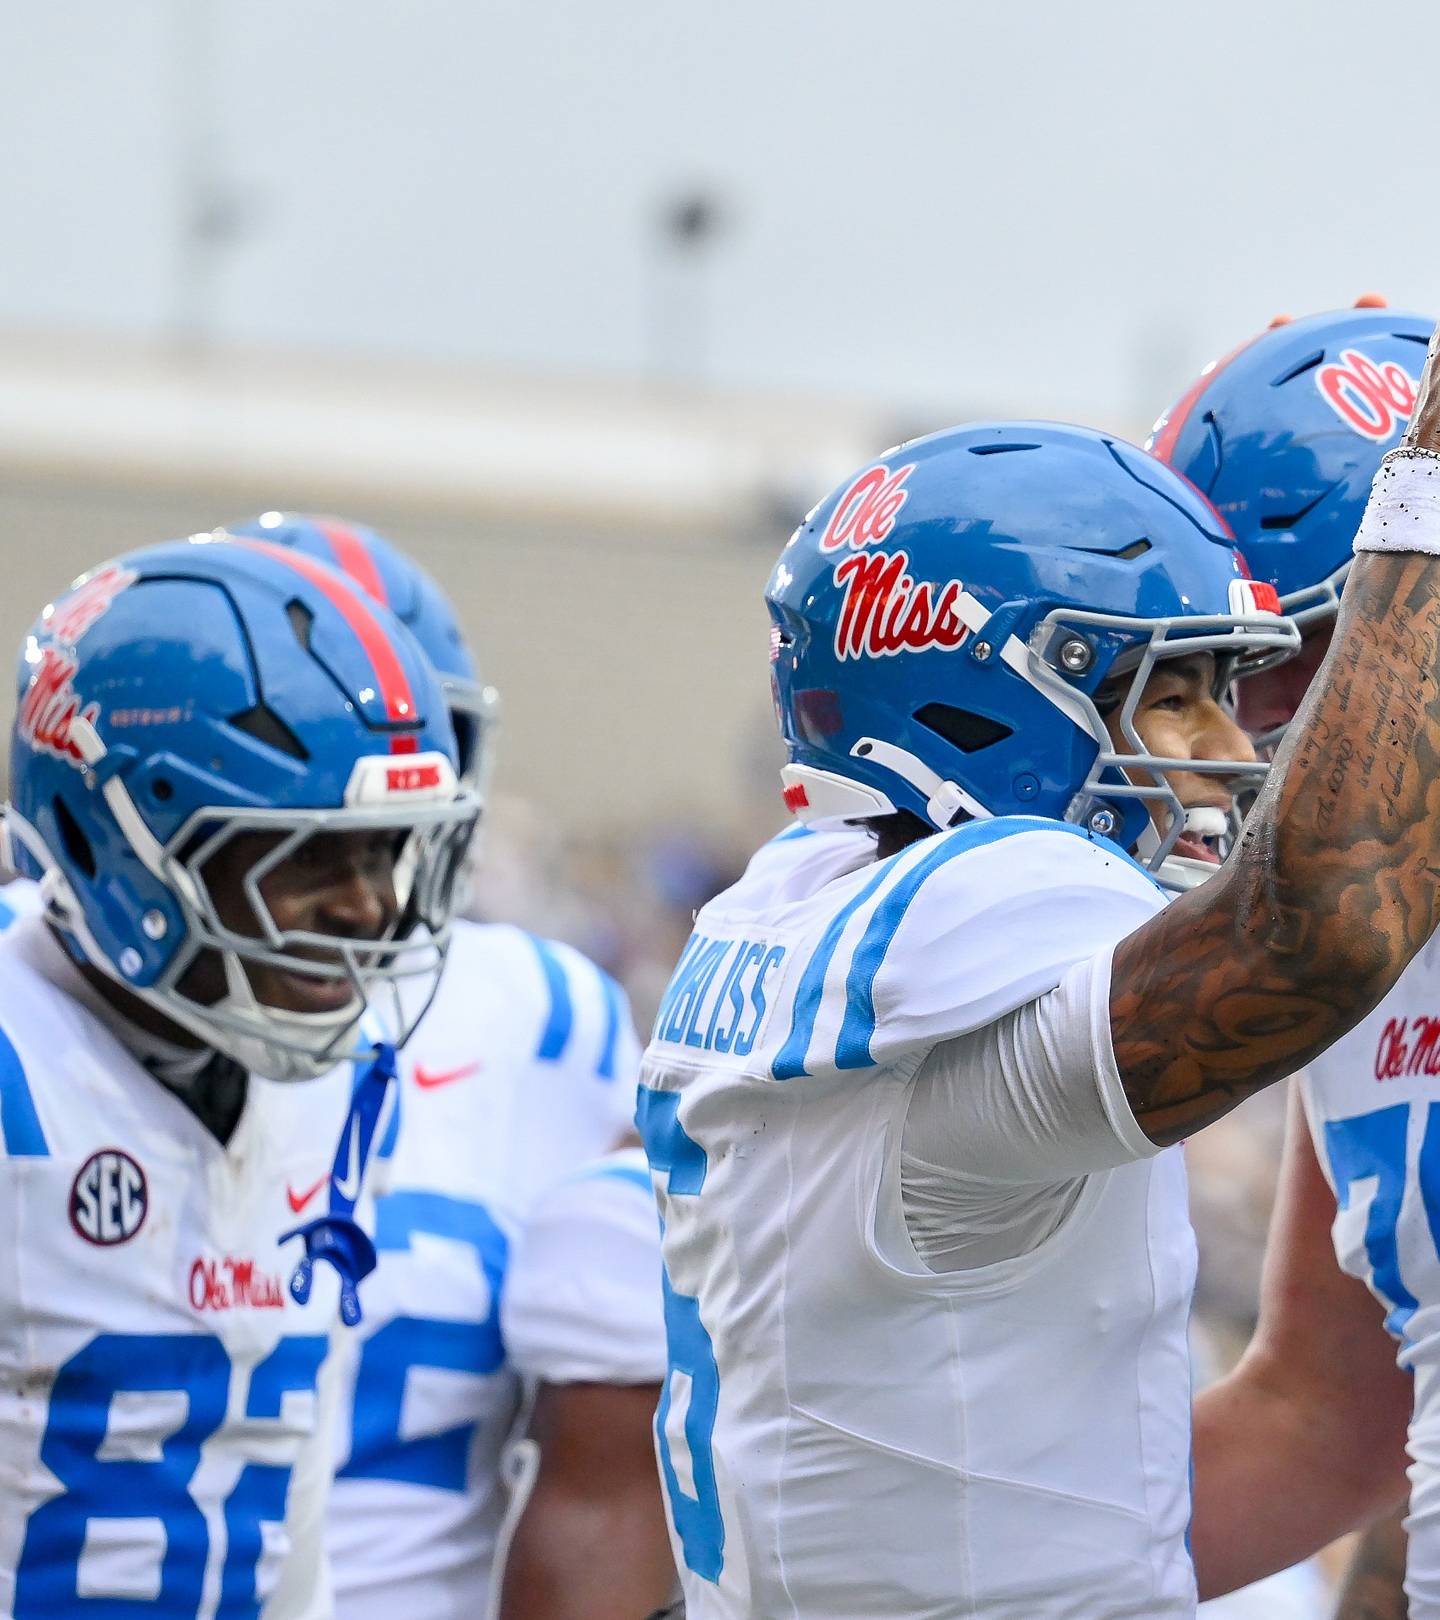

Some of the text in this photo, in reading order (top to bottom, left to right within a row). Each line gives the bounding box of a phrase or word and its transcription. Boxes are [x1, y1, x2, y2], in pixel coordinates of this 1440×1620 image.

[1315, 350, 1421, 440] Ole
[818, 463, 917, 554] Ole
[833, 550, 971, 662] Miss
[1375, 1016, 1408, 1082] Ole
[76, 1154, 143, 1238] SEC
[189, 1255, 229, 1311] Ole
[11, 1332, 332, 1620] 82
